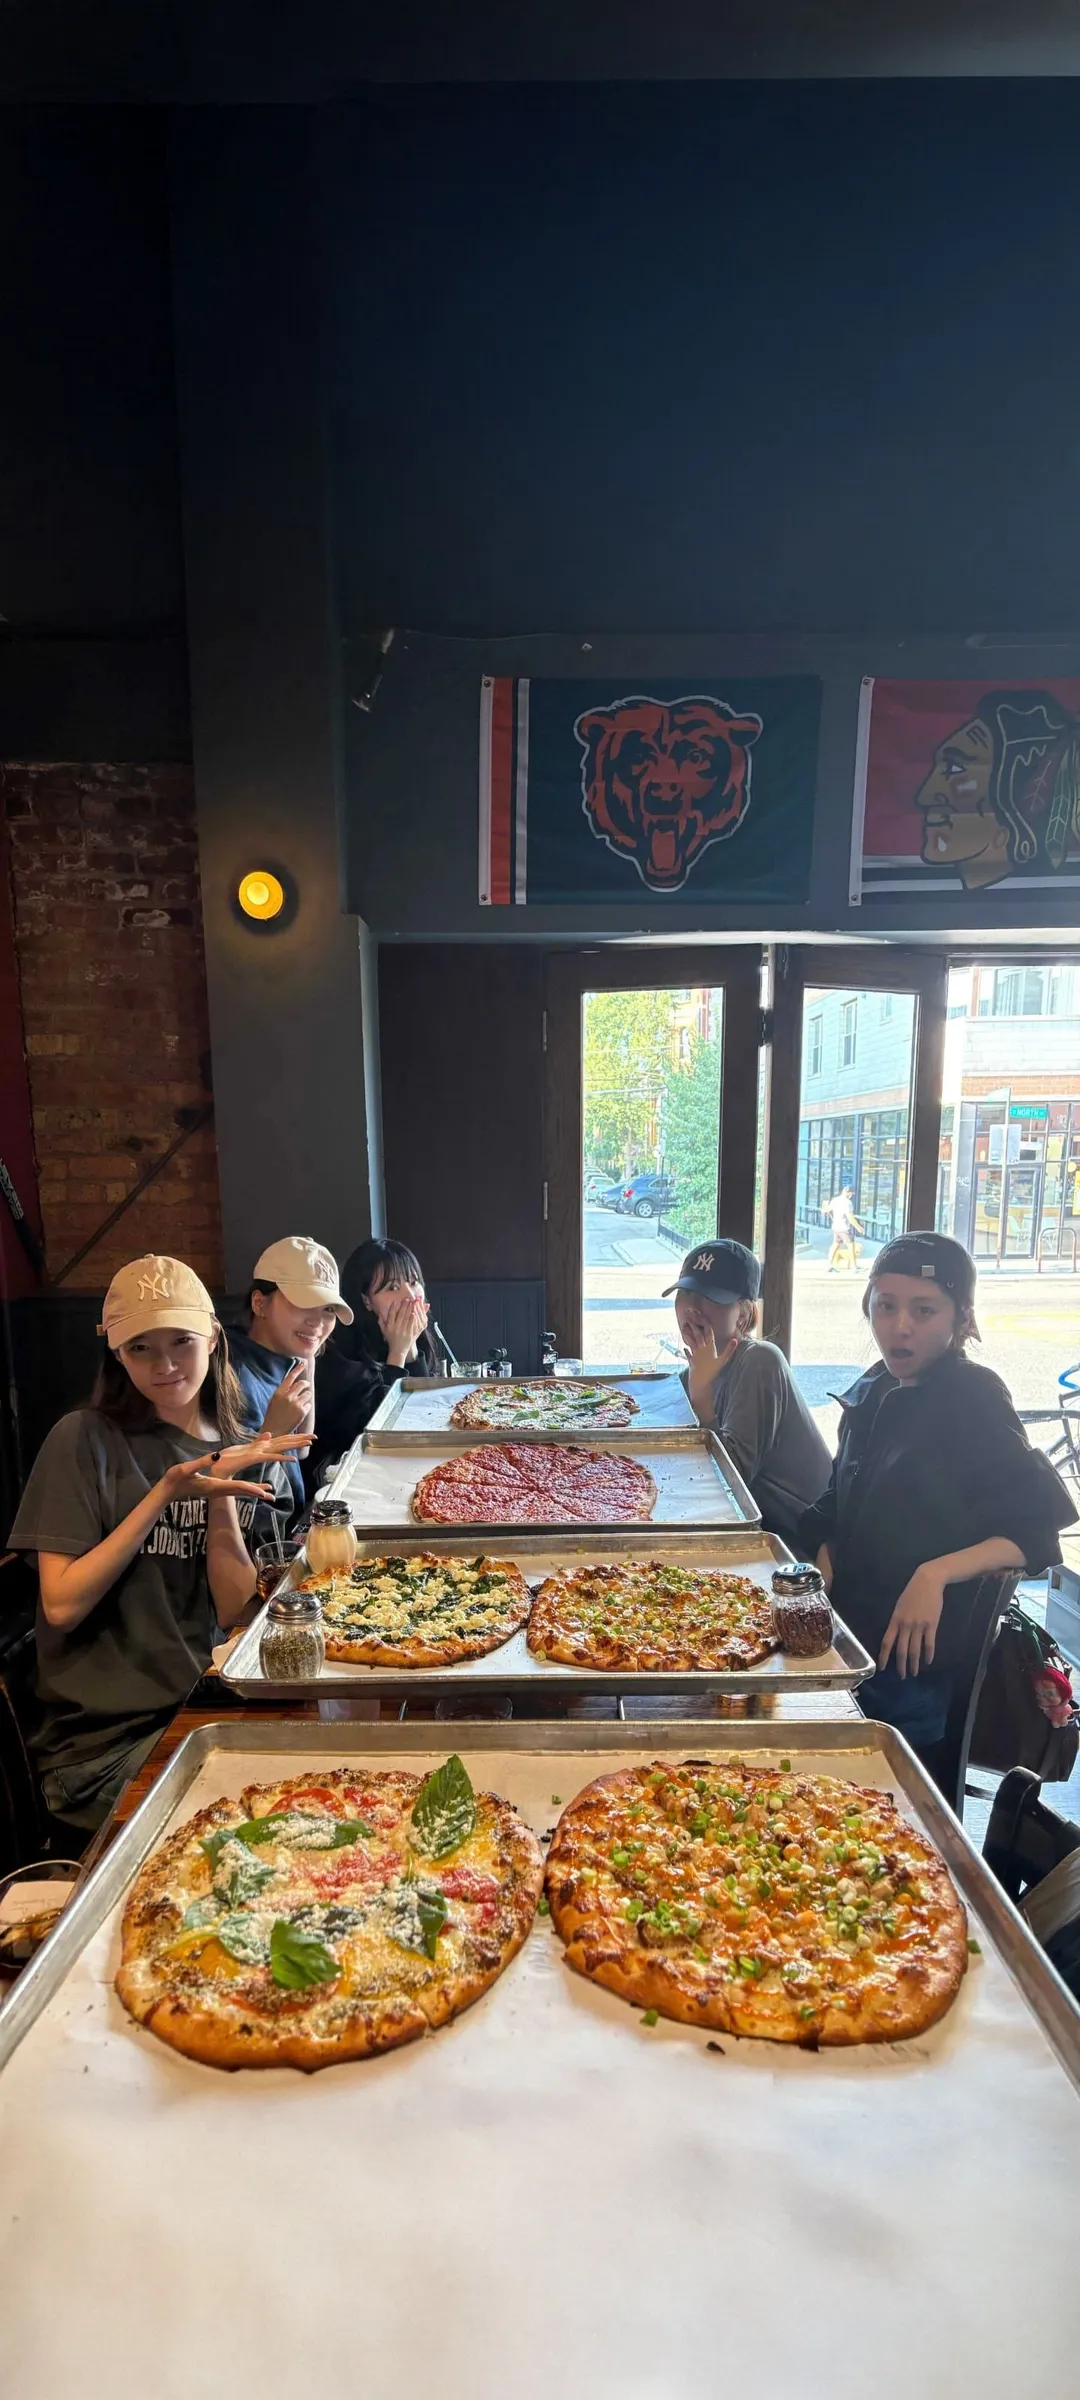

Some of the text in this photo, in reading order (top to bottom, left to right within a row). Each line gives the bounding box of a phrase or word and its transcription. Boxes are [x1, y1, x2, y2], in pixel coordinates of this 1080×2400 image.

[1016, 1107, 1038, 1117] NORTH
[693, 1252, 715, 1272] NY
[137, 1272, 170, 1301] NY
